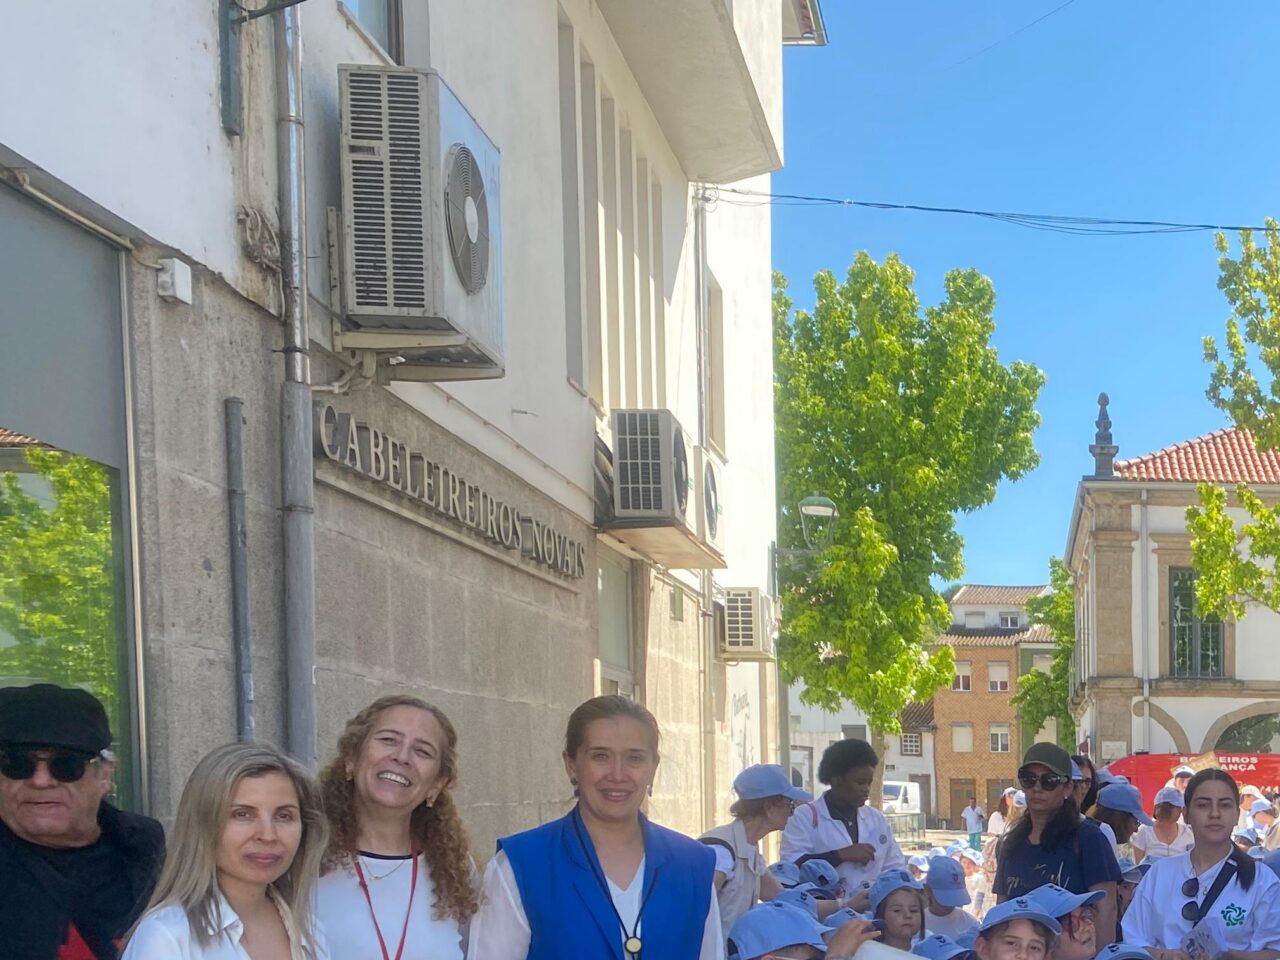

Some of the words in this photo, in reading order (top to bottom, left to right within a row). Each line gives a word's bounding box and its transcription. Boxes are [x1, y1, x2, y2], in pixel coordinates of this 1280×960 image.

[319, 405, 522, 550] CABELEIREIROS
[531, 519, 586, 579] NOVAIS
[1180, 756, 1258, 764] BEIROS
[1219, 763, 1257, 772] ANÇA
